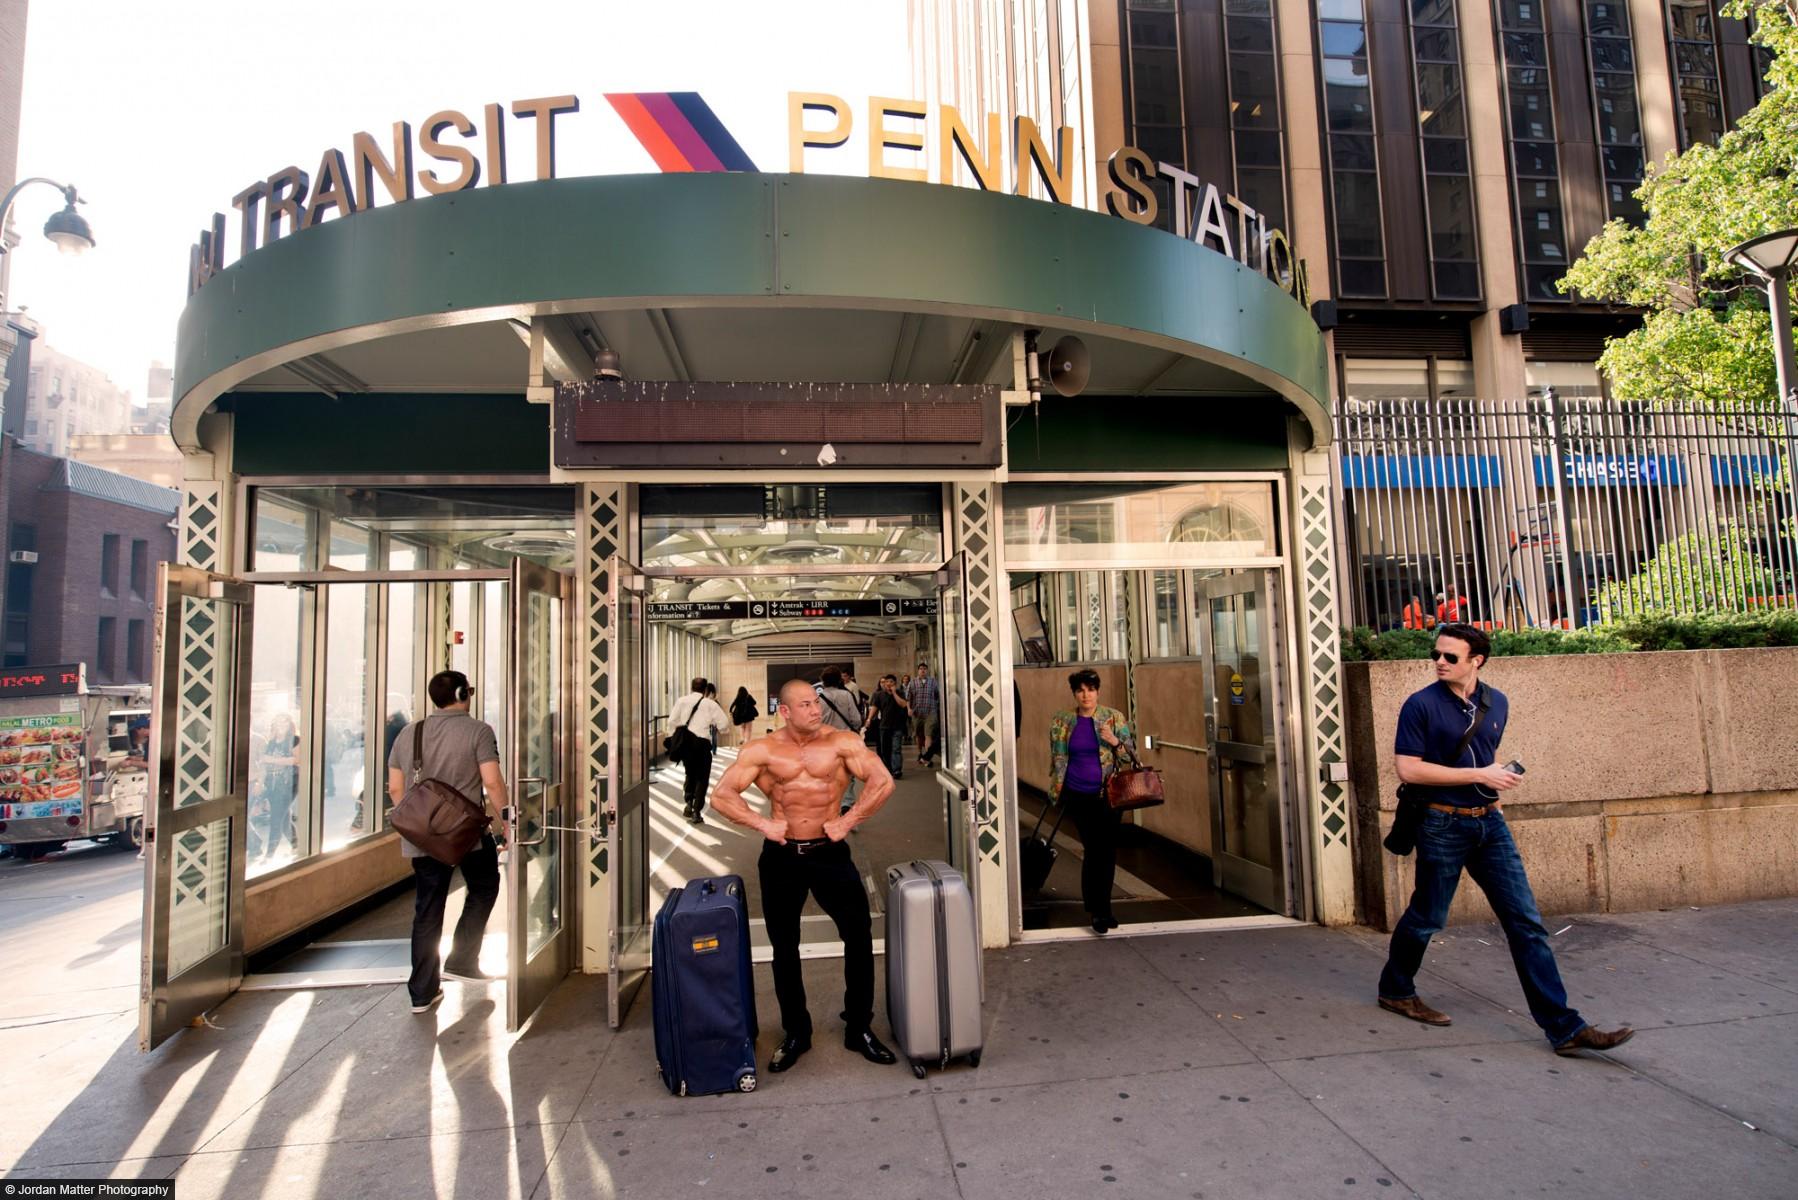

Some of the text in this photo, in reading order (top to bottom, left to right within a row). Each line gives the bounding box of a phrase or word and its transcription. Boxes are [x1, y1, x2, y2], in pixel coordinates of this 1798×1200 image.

[231, 94, 579, 259] TRANSIT
[788, 91, 1310, 313] PENN STATION
[1563, 461, 1639, 479] CHASE
[648, 611, 685, 619] nformation
[22, 717, 52, 727] METRO
